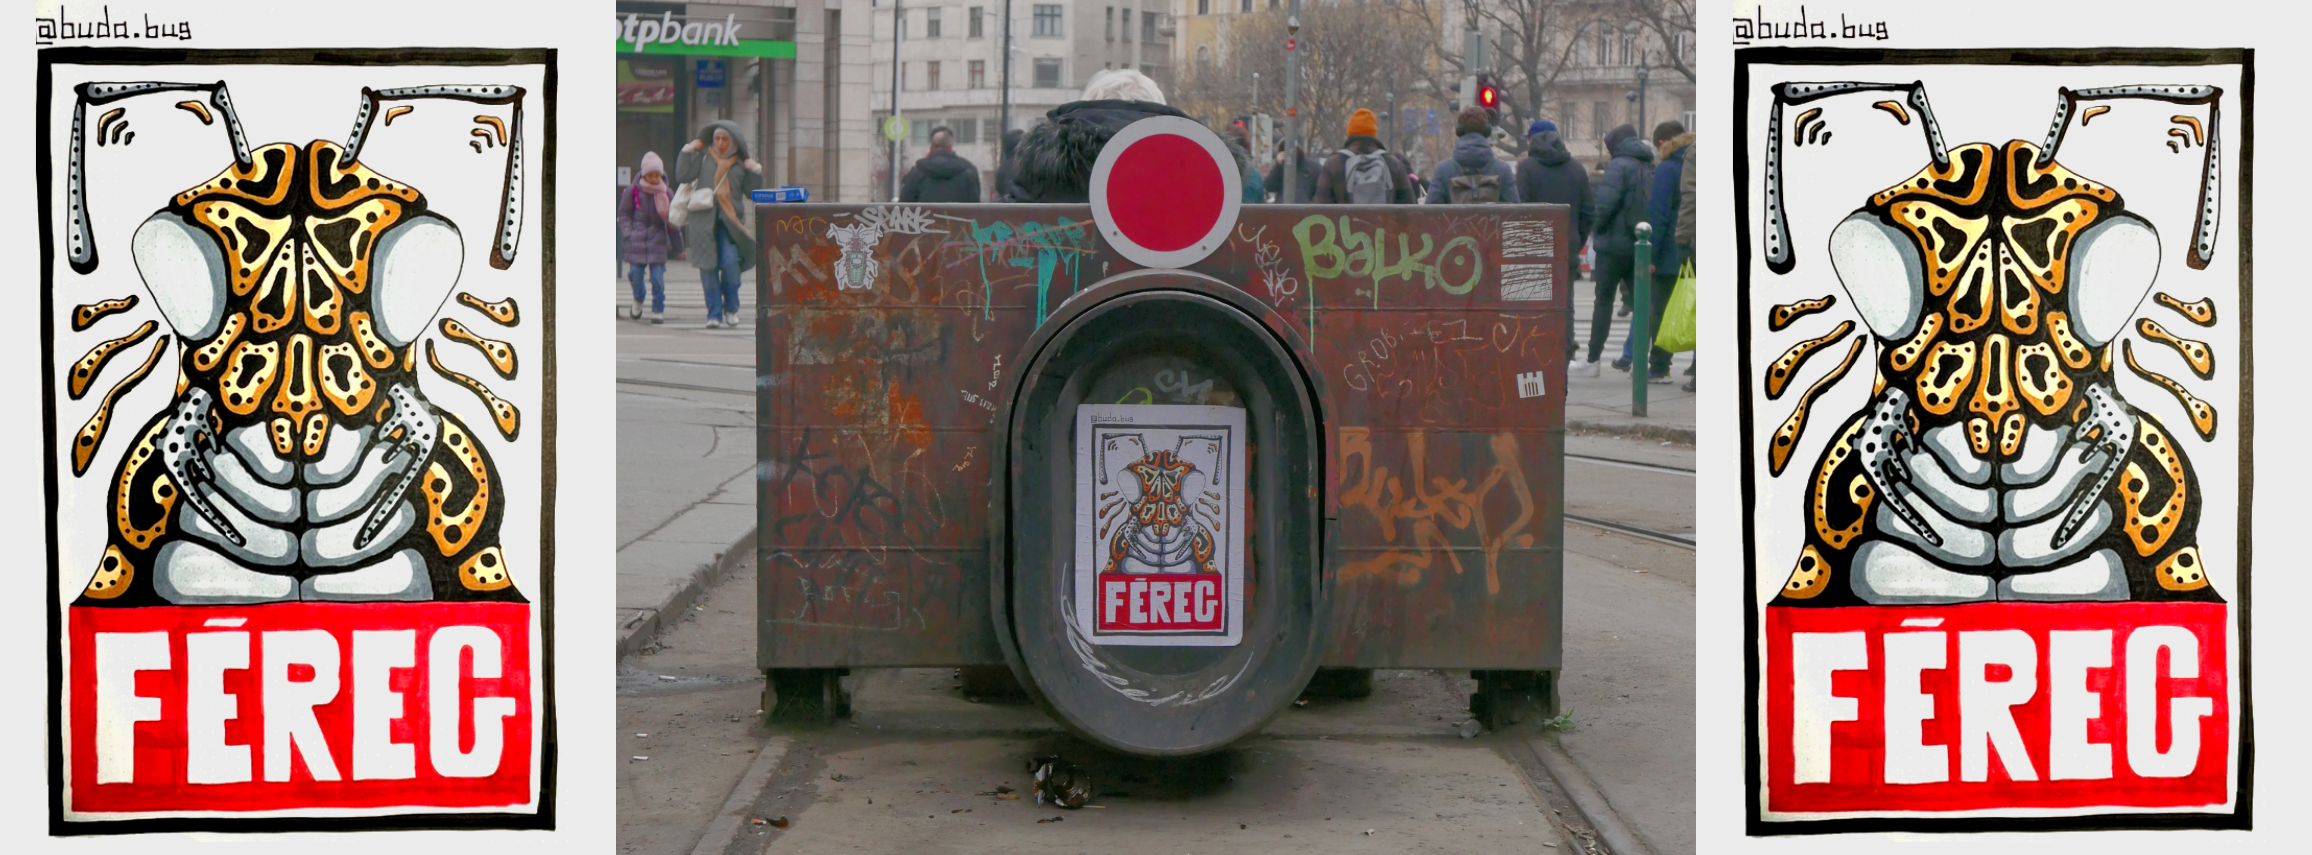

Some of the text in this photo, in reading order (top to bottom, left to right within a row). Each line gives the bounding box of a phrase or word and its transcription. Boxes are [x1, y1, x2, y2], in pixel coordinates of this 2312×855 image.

[36, 5, 192, 45] @buda.bug
[1733, 5, 1889, 45] @buda.bug
[1091, 412, 1134, 424] @buda.bug
[95, 617, 516, 785] FÉREG
[1792, 617, 2213, 785] FÉREG
